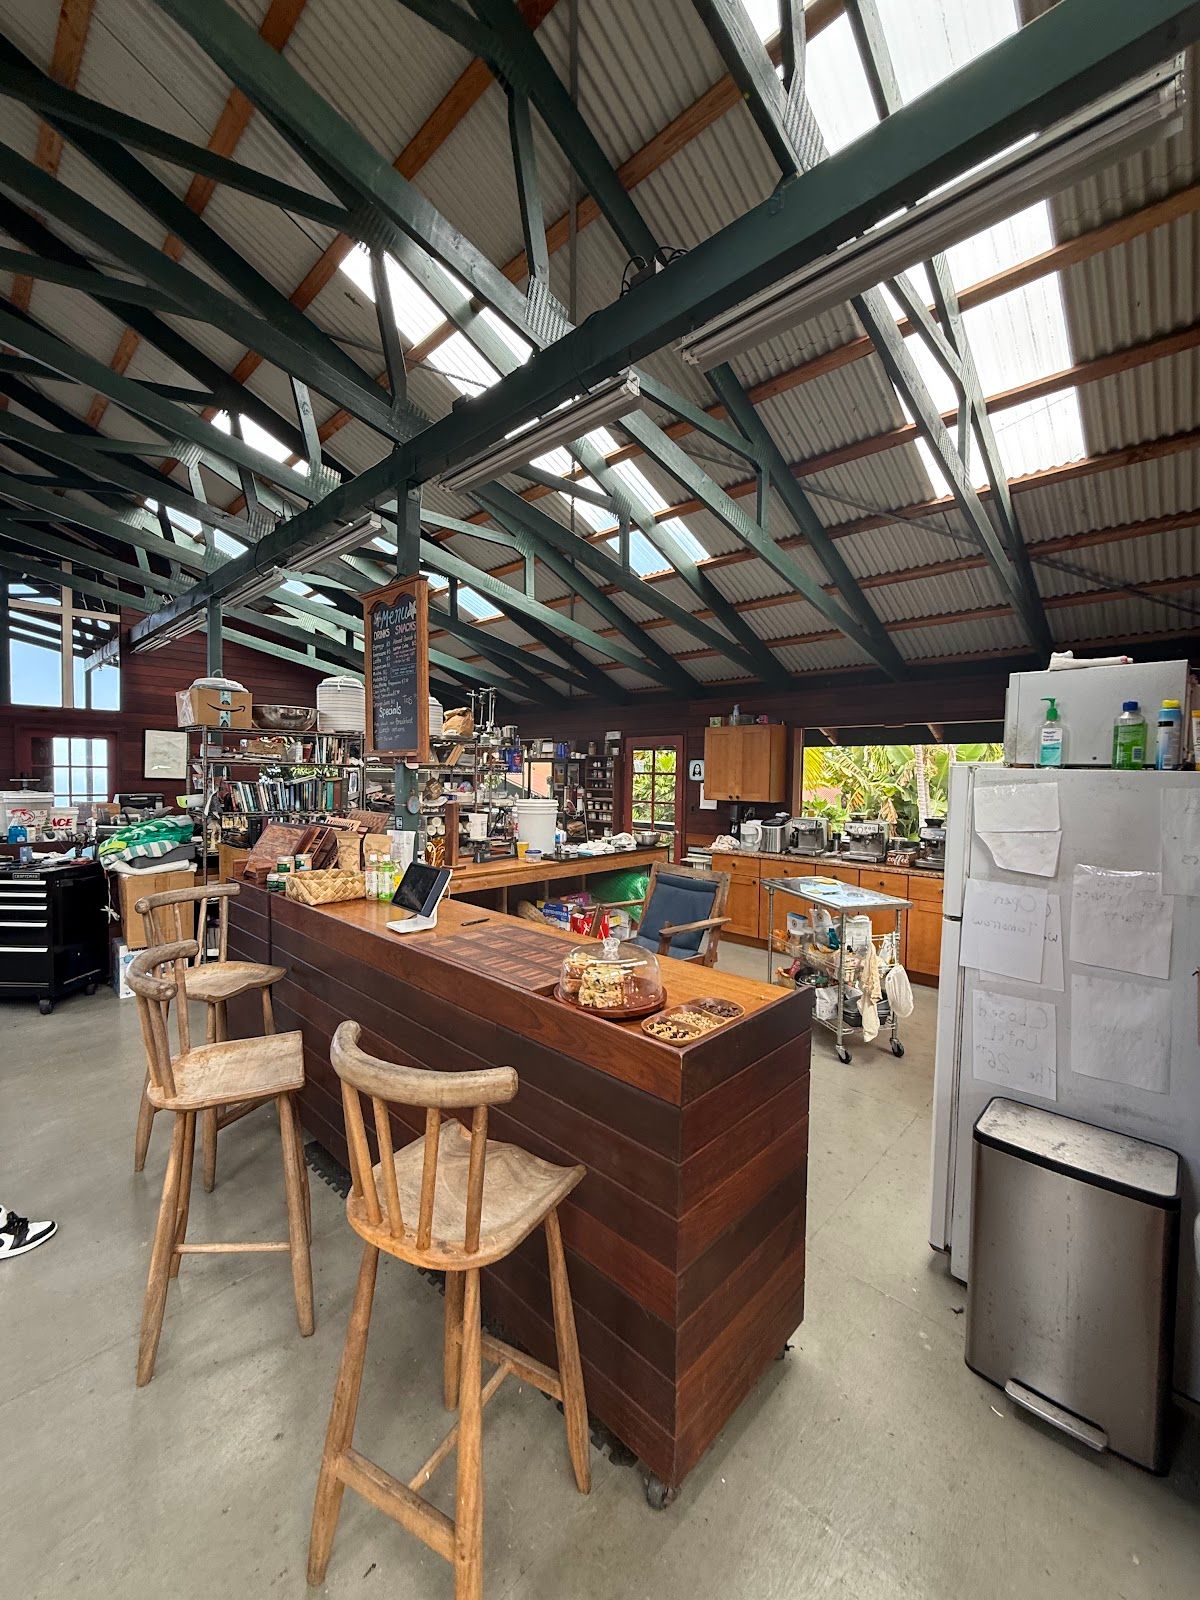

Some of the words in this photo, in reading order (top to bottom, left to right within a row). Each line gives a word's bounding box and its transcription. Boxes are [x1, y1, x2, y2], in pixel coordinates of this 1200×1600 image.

[380, 606, 409, 629] Menu
[373, 628, 390, 641] DRINKS
[394, 621, 417, 635] SNACKS
[379, 701, 402, 719] Specials
[887, 854, 910, 866] coffee
